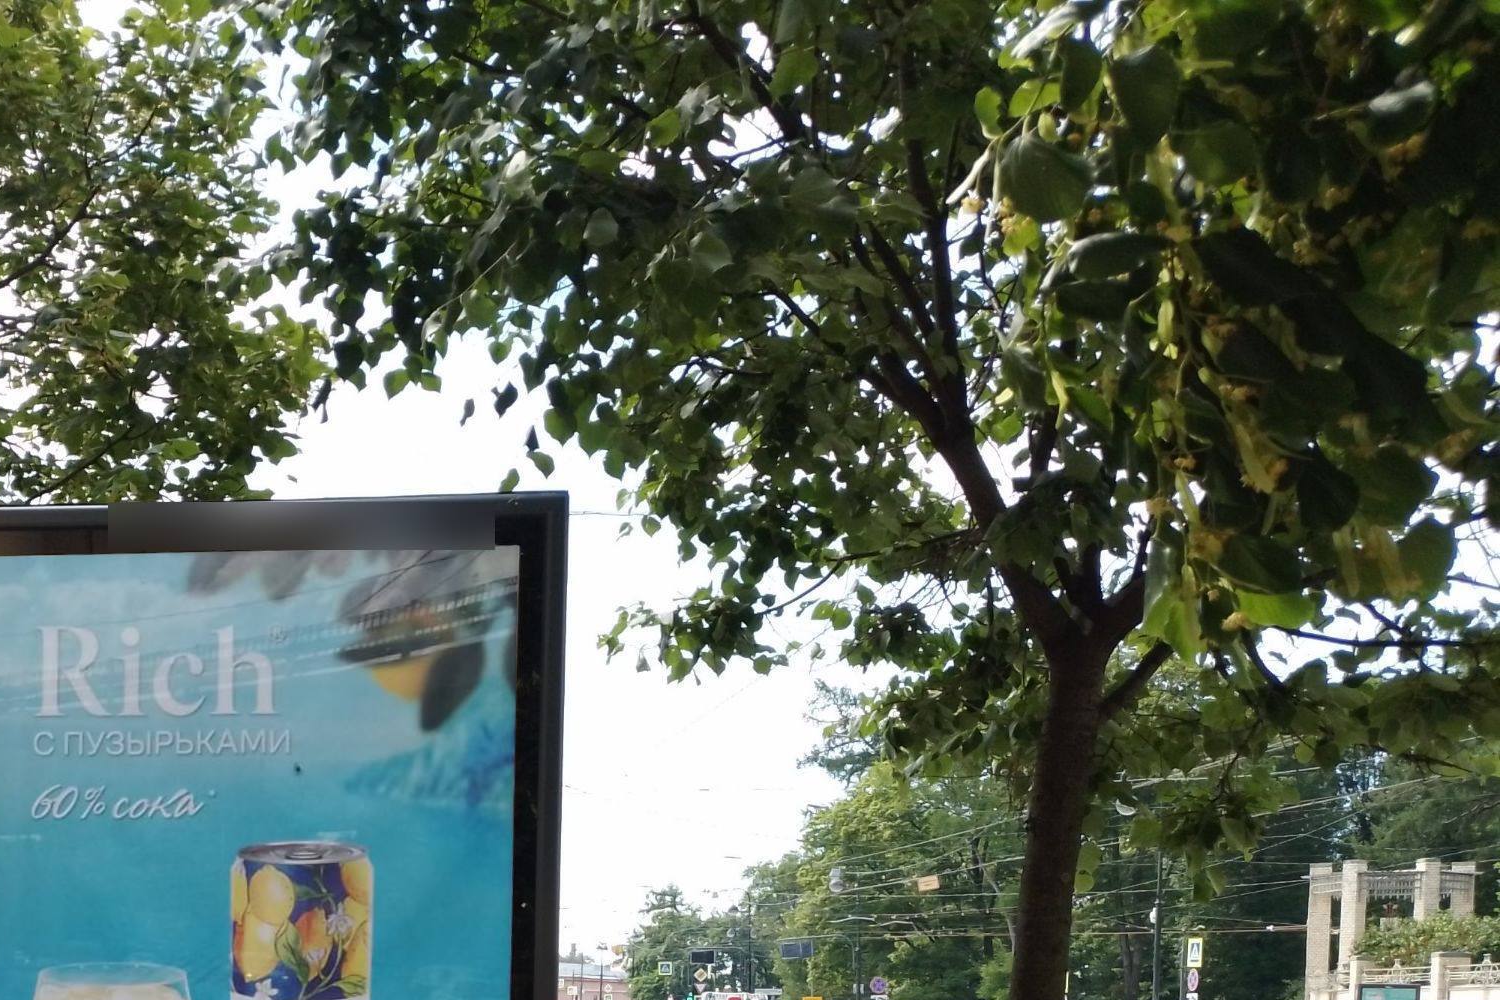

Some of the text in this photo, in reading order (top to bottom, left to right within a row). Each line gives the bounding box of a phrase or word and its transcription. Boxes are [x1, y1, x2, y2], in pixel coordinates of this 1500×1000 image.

[36, 625, 277, 717] Rich
[33, 729, 292, 756] С ПУЗЫРЬКАМИ
[31, 784, 106, 819] 60%
